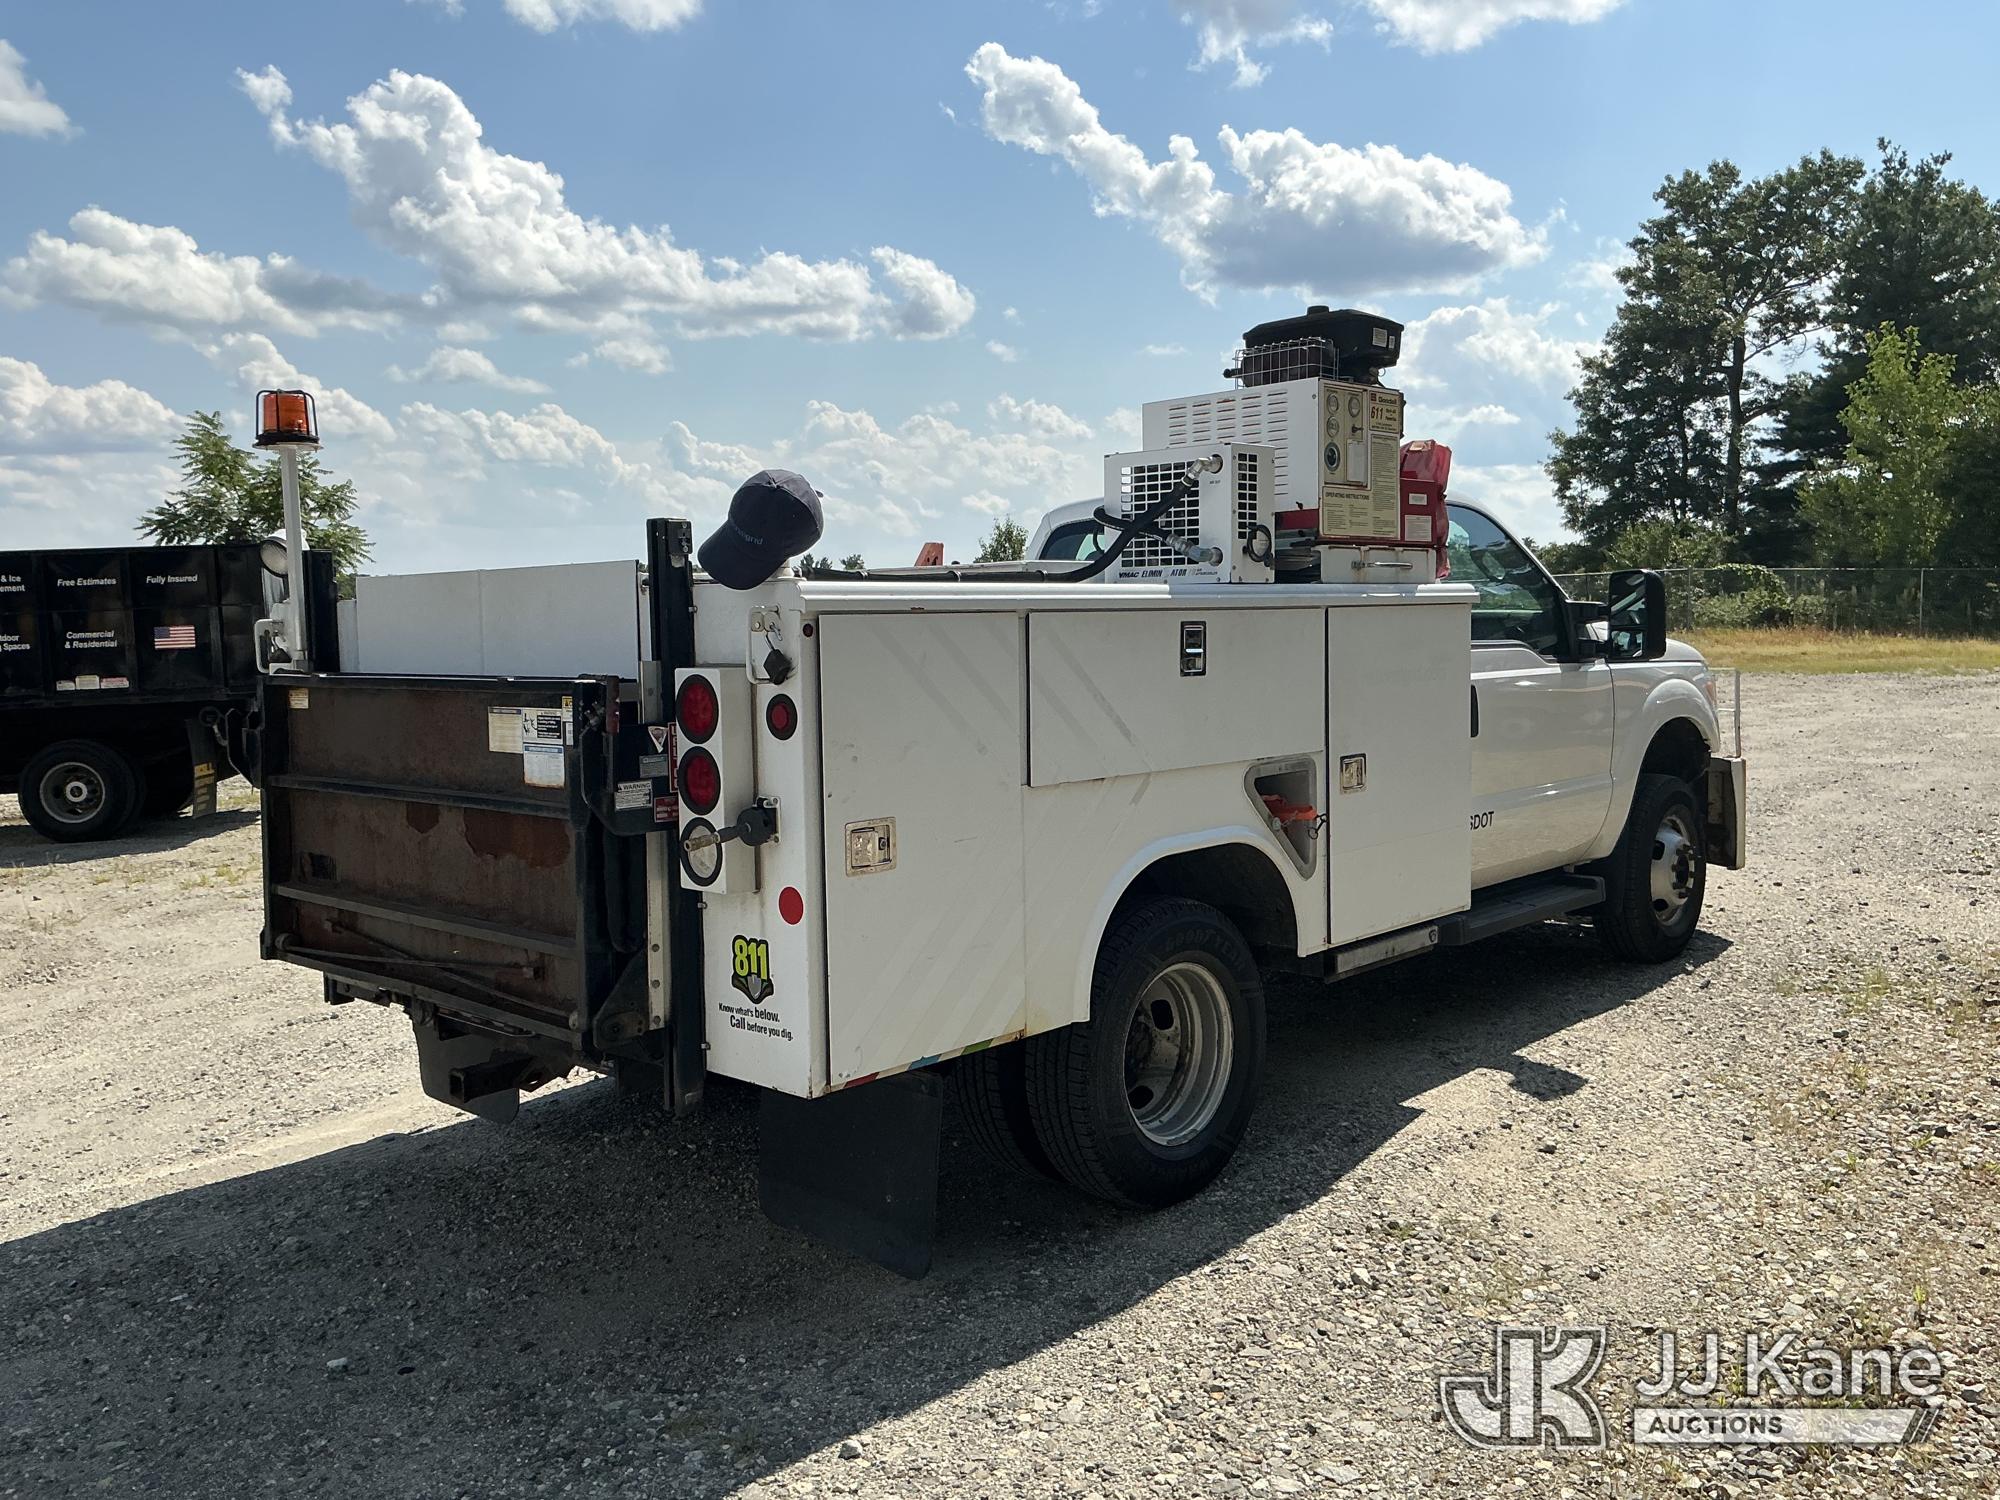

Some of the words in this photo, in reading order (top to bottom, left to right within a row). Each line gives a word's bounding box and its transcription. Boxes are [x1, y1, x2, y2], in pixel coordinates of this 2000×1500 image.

[1371, 406, 1384, 420] 611
[8, 574, 22, 583] Ice
[57, 578, 76, 587] Free
[77, 577, 117, 586] Estimates
[146, 575, 166, 585] Fully
[167, 573, 198, 583] Insured
[0, 634, 20, 642] door
[66, 630, 115, 639] Commercial
[3, 642, 31, 652] Spaces
[64, 641, 71, 649] &
[72, 639, 118, 649] Residential
[623, 782, 651, 790] WARNING
[734, 938, 768, 980] 811
[719, 1002, 735, 1014] Know
[735, 1007, 754, 1018] what's
[755, 1007, 781, 1023] below.
[730, 1014, 746, 1030] Call
[746, 1021, 768, 1034] before
[768, 1025, 781, 1037] you
[781, 1028, 794, 1041] dig.
